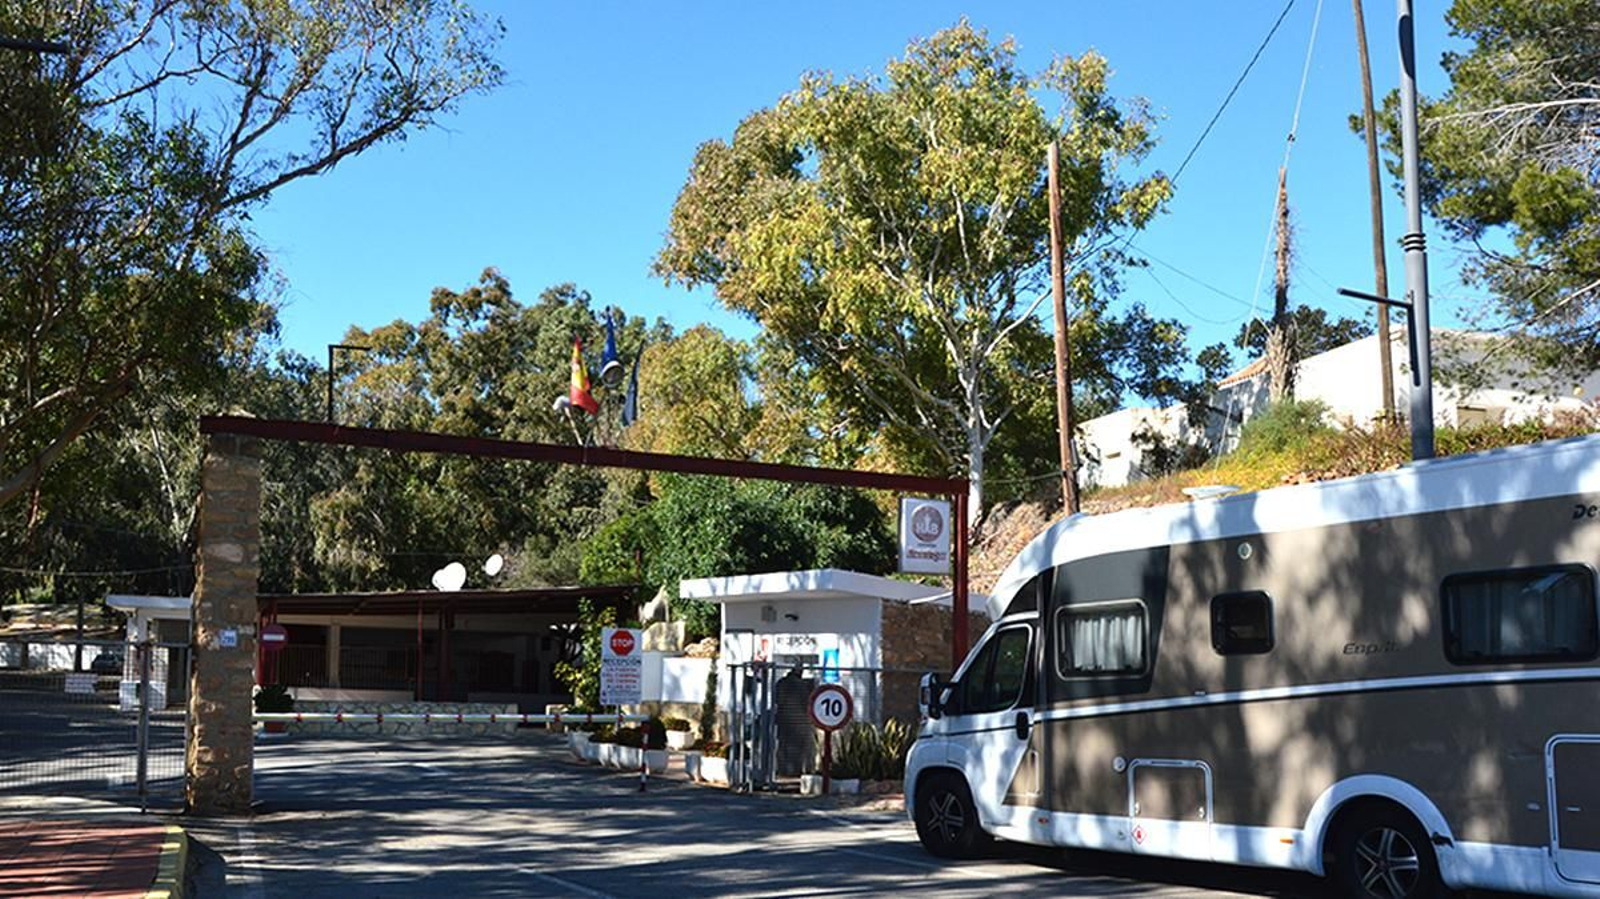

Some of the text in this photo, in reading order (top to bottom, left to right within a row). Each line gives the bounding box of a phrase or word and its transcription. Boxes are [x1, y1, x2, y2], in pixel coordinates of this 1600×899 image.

[1573, 504, 1600, 520] De
[612, 638, 633, 648] STOP
[821, 698, 842, 717] 10
